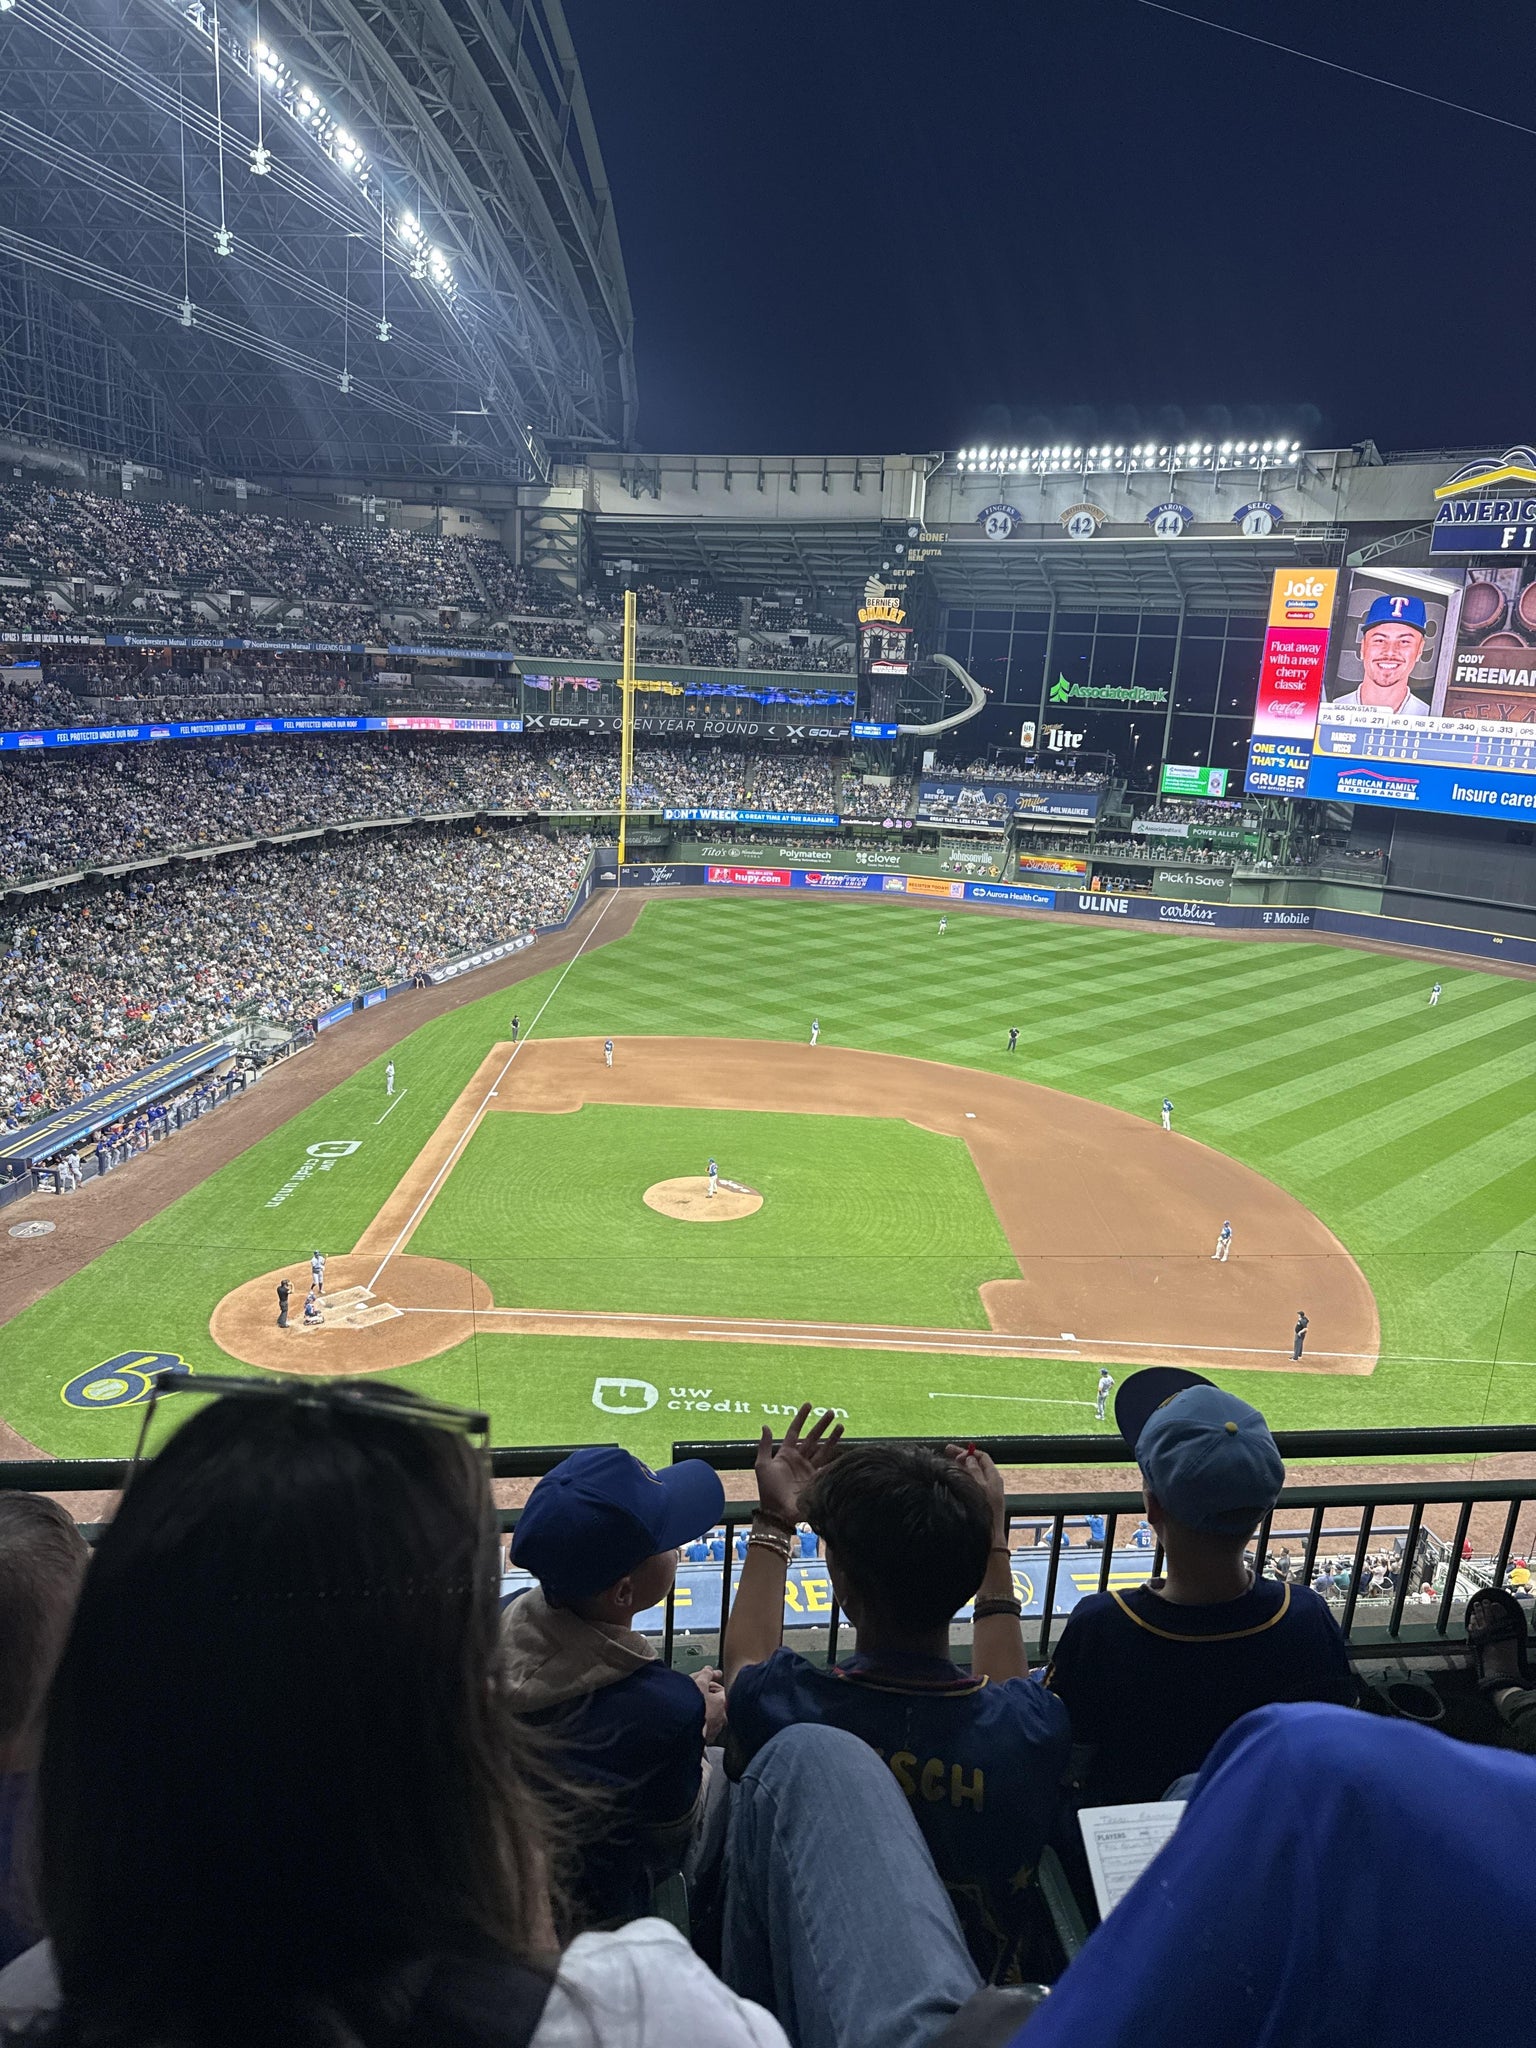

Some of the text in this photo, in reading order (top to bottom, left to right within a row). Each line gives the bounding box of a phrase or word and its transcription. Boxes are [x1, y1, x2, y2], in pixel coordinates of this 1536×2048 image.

[985, 504, 1015, 515] FINGERS
[1066, 504, 1100, 516] ROBINSON
[1158, 504, 1183, 512] AARON
[1248, 502, 1271, 511] SELIG
[988, 517, 1008, 534] 34
[1070, 517, 1092, 534] 42
[1158, 516, 1179, 534] 44
[1252, 517, 1262, 534] 1
[919, 532, 948, 542] GONE!
[1284, 577, 1324, 596] Joie
[866, 598, 899, 607] BERNIE'S
[858, 608, 906, 624] CHALET
[132, 637, 168, 646] Northwestern
[1271, 642, 1321, 654] Float away
[1270, 654, 1290, 664] with
[1458, 654, 1485, 664] CODY
[1276, 667, 1309, 679] cherry
[1274, 680, 1306, 690] classic
[550, 718, 590, 726] GOLF
[612, 718, 758, 735] OEN YEAR ROUND
[190, 725, 213, 733] PROTECTED
[808, 728, 850, 738] GOLF
[57, 733, 70, 742] FEEL
[70, 732, 98, 741] PROTECTED
[100, 730, 116, 739] UNDER
[1048, 729, 1084, 752] Lite
[1253, 743, 1275, 753] ONE
[1251, 756, 1310, 770] THAT'S ALL!
[1250, 772, 1305, 789] GRUBER
[1338, 777, 1417, 792] AMERICAN FAMILY
[1343, 786, 1410, 798] INSURANCE
[1452, 784, 1497, 804] Insure
[1016, 797, 1049, 810] Miller
[666, 809, 698, 819] DON'T
[700, 810, 738, 820] WRECK
[1032, 806, 1089, 816] TIME, MILWAUKEE
[1193, 829, 1240, 838] POWER ALLEY
[702, 847, 727, 856] Tito's
[780, 849, 832, 862] Polymatech
[949, 850, 992, 864] Johnsonville
[868, 854, 900, 864] clover
[735, 873, 781, 883] hupy.com
[1159, 871, 1183, 883] Pick
[1195, 875, 1224, 887] Save
[986, 887, 1049, 903] Aurora Health Care
[1079, 895, 1129, 914] ULINE
[1160, 903, 1217, 919] carbliss
[1274, 912, 1310, 924] Mobile
[264, 1182, 299, 1208] union
[669, 1387, 713, 1398] uw
[667, 1400, 751, 1413] credit
[1142, 1537, 1150, 1545] 67
[1097, 1832, 1127, 1840] PLAYERS
